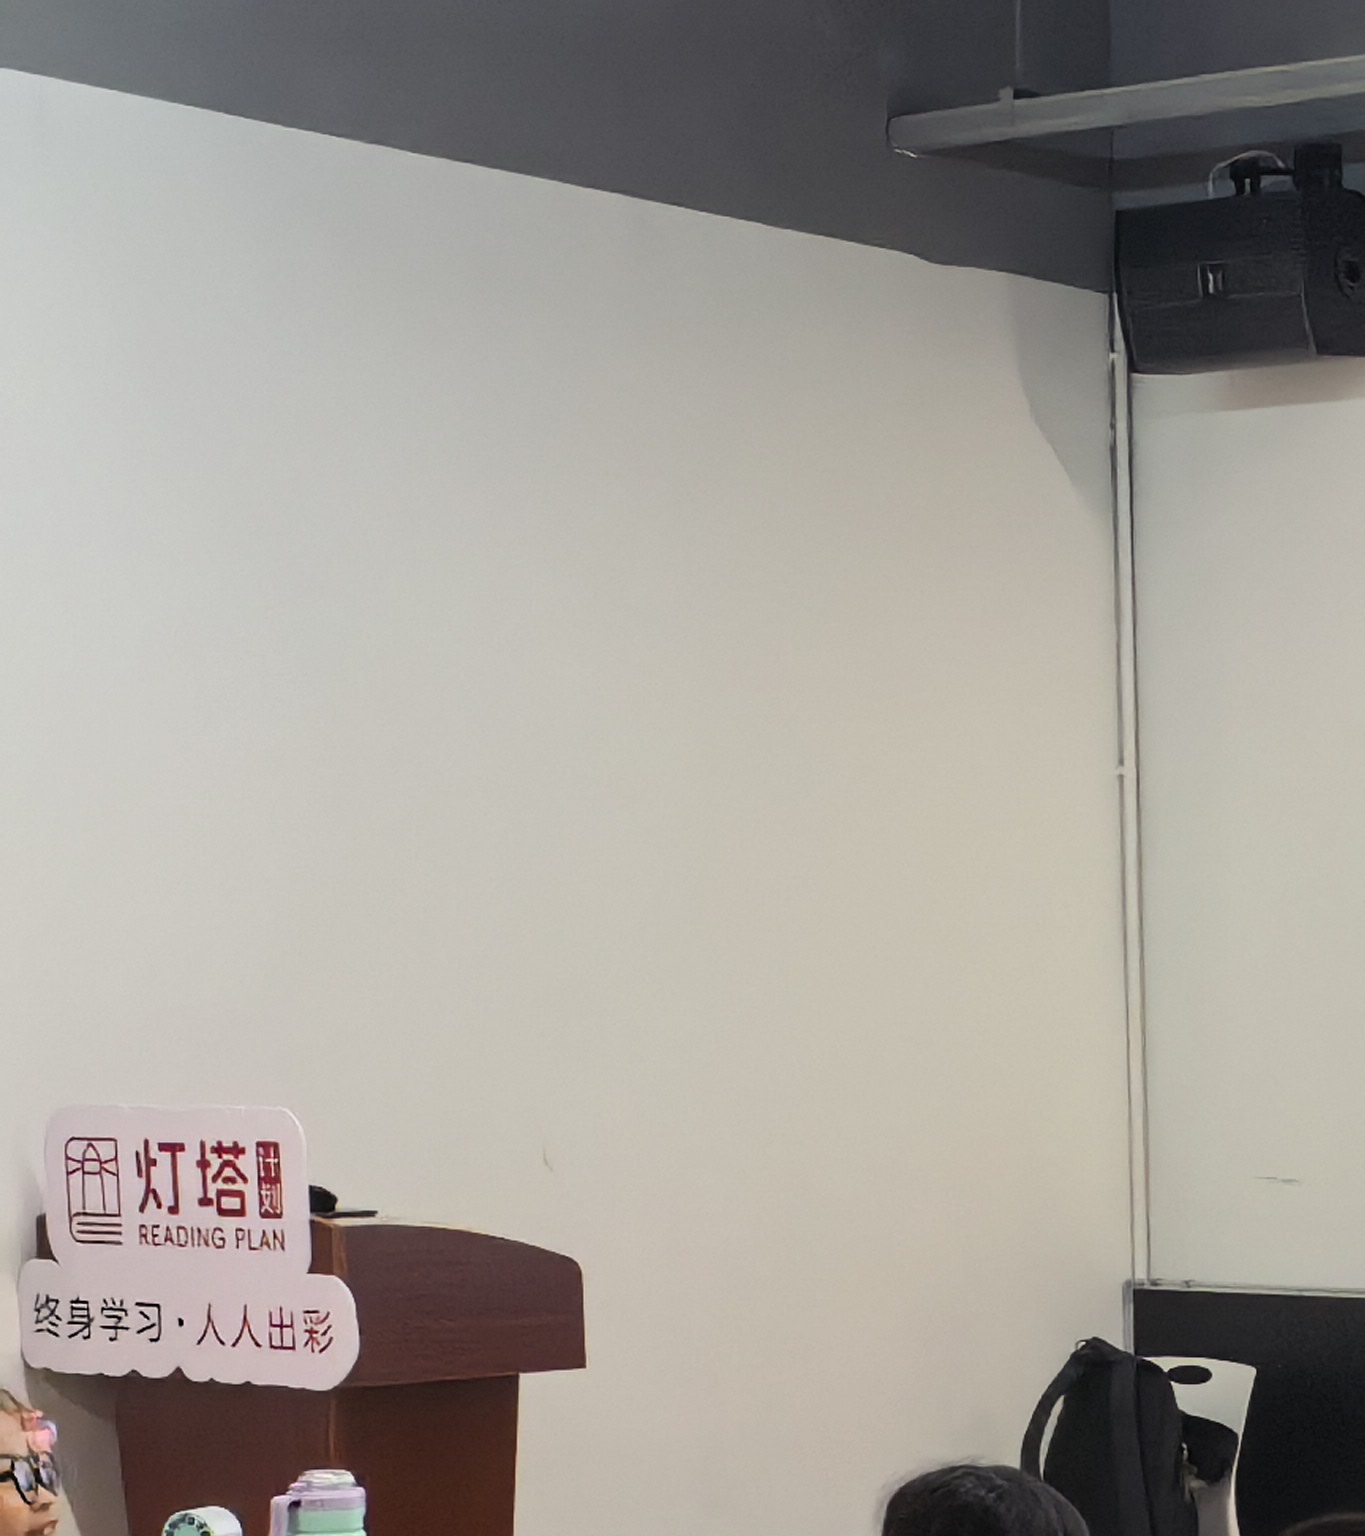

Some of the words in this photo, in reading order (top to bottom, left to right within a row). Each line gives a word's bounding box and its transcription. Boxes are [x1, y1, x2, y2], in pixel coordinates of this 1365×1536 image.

[134, 1138, 249, 1218] 灯塔
[138, 1224, 226, 1249] READING
[235, 1227, 286, 1252] PLAN
